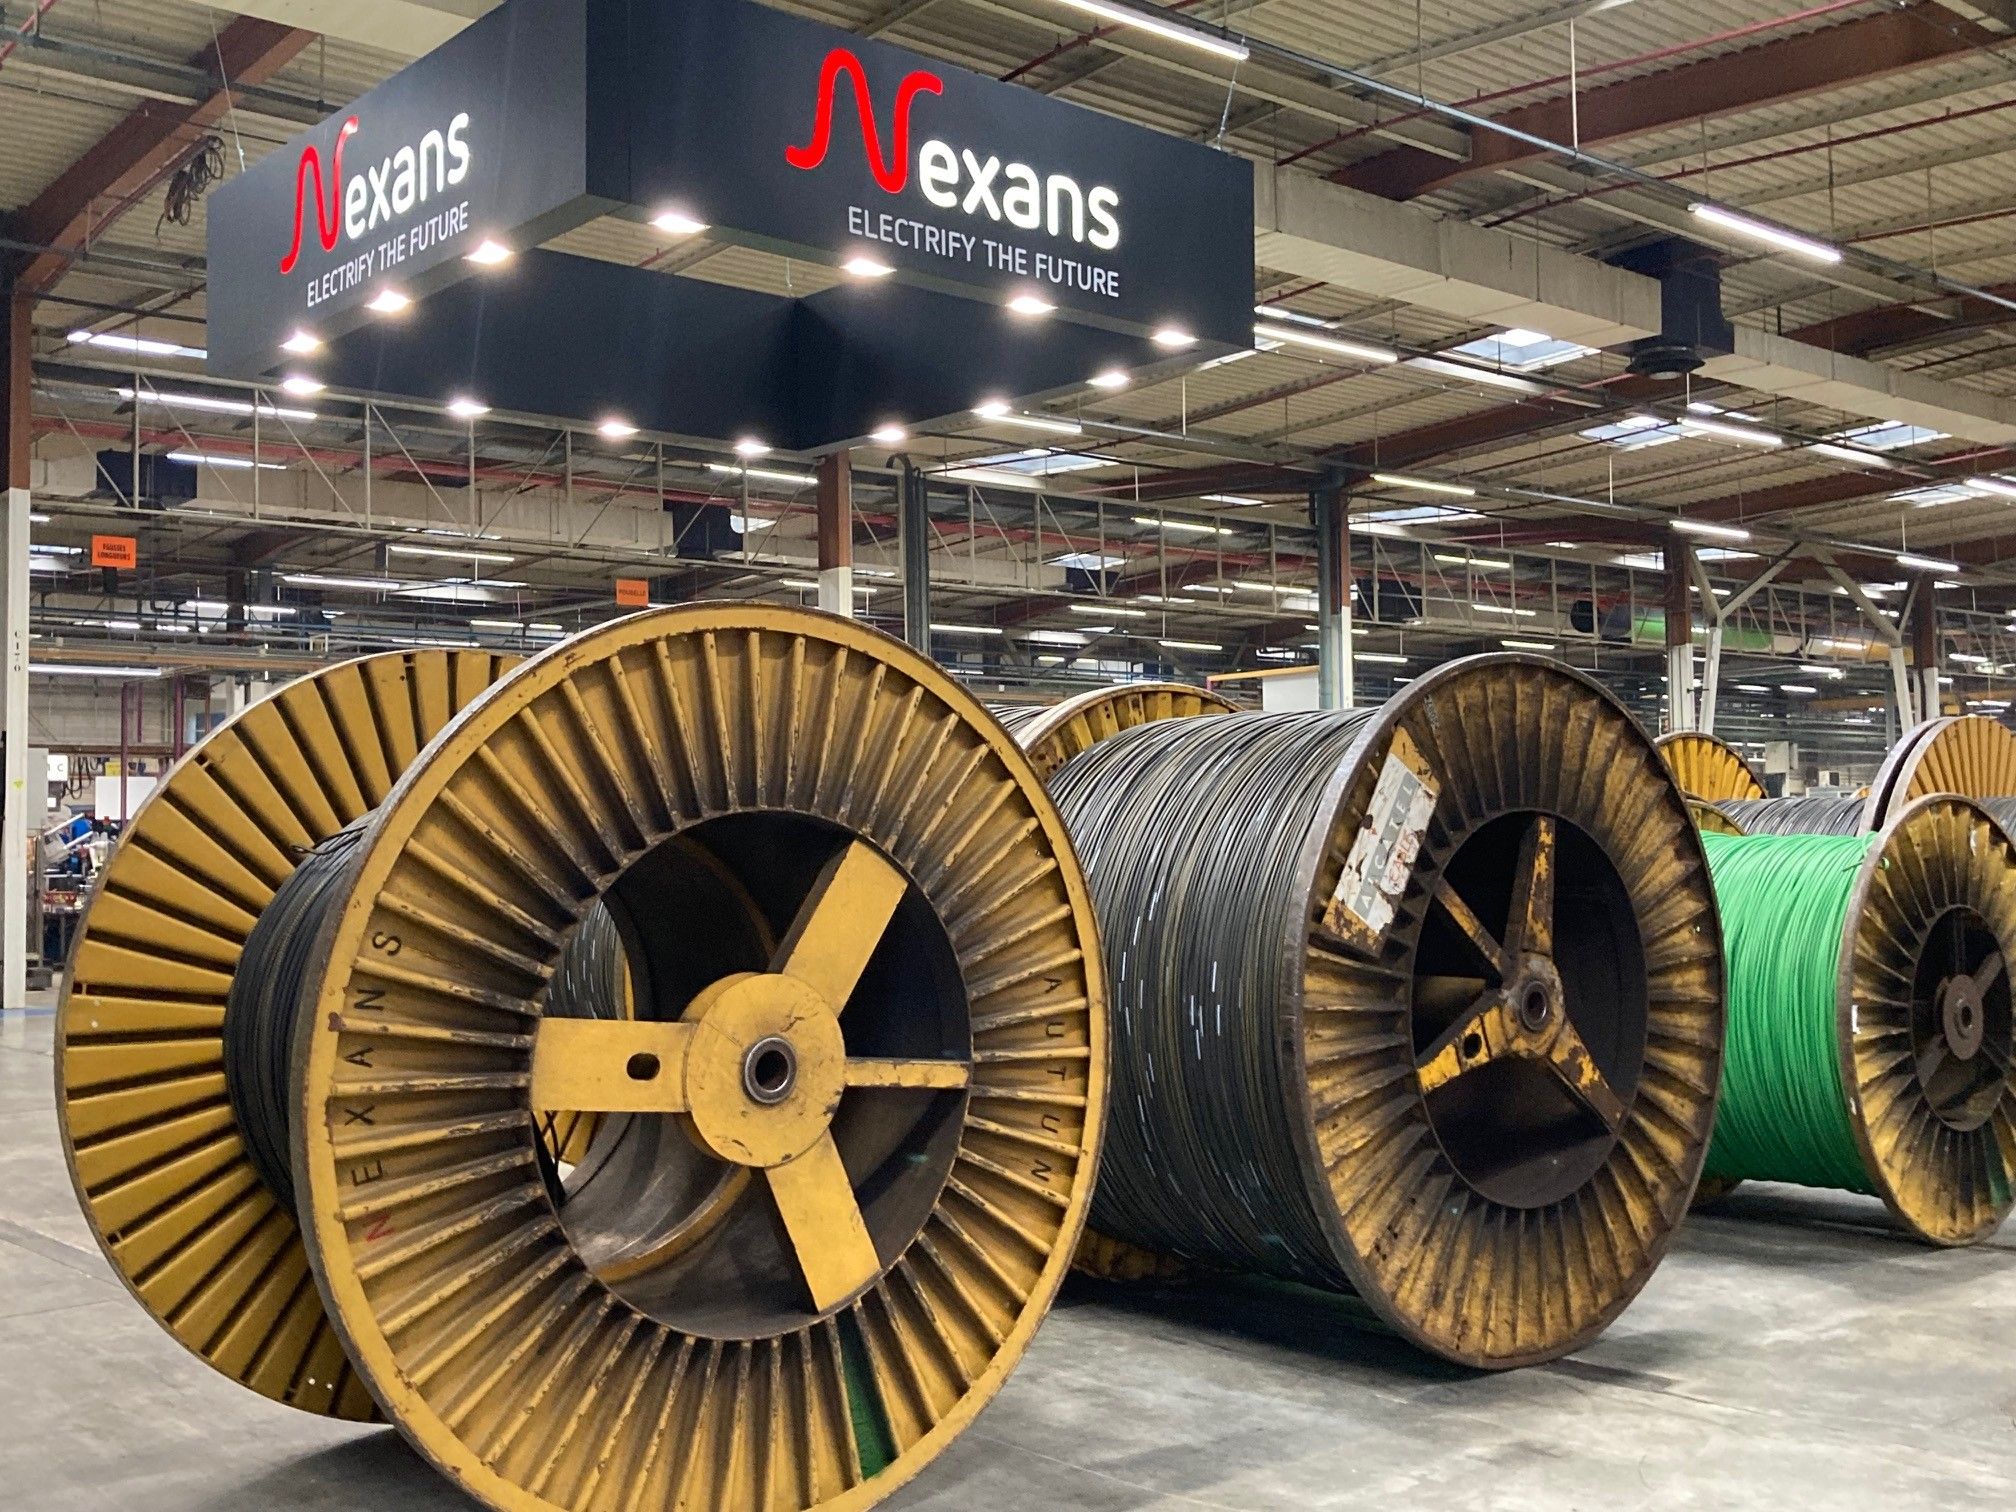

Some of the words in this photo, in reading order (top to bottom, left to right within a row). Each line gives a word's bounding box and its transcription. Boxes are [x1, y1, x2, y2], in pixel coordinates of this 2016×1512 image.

[280, 112, 470, 275] Nexans
[785, 48, 1120, 250] Nexans
[307, 249, 375, 307] ELECTRIFY
[378, 233, 406, 271] THE
[410, 201, 469, 257] FUTURE
[848, 205, 976, 262] ELECTRIFY
[983, 239, 1027, 275] THE
[1035, 253, 1120, 298] FUTURE
